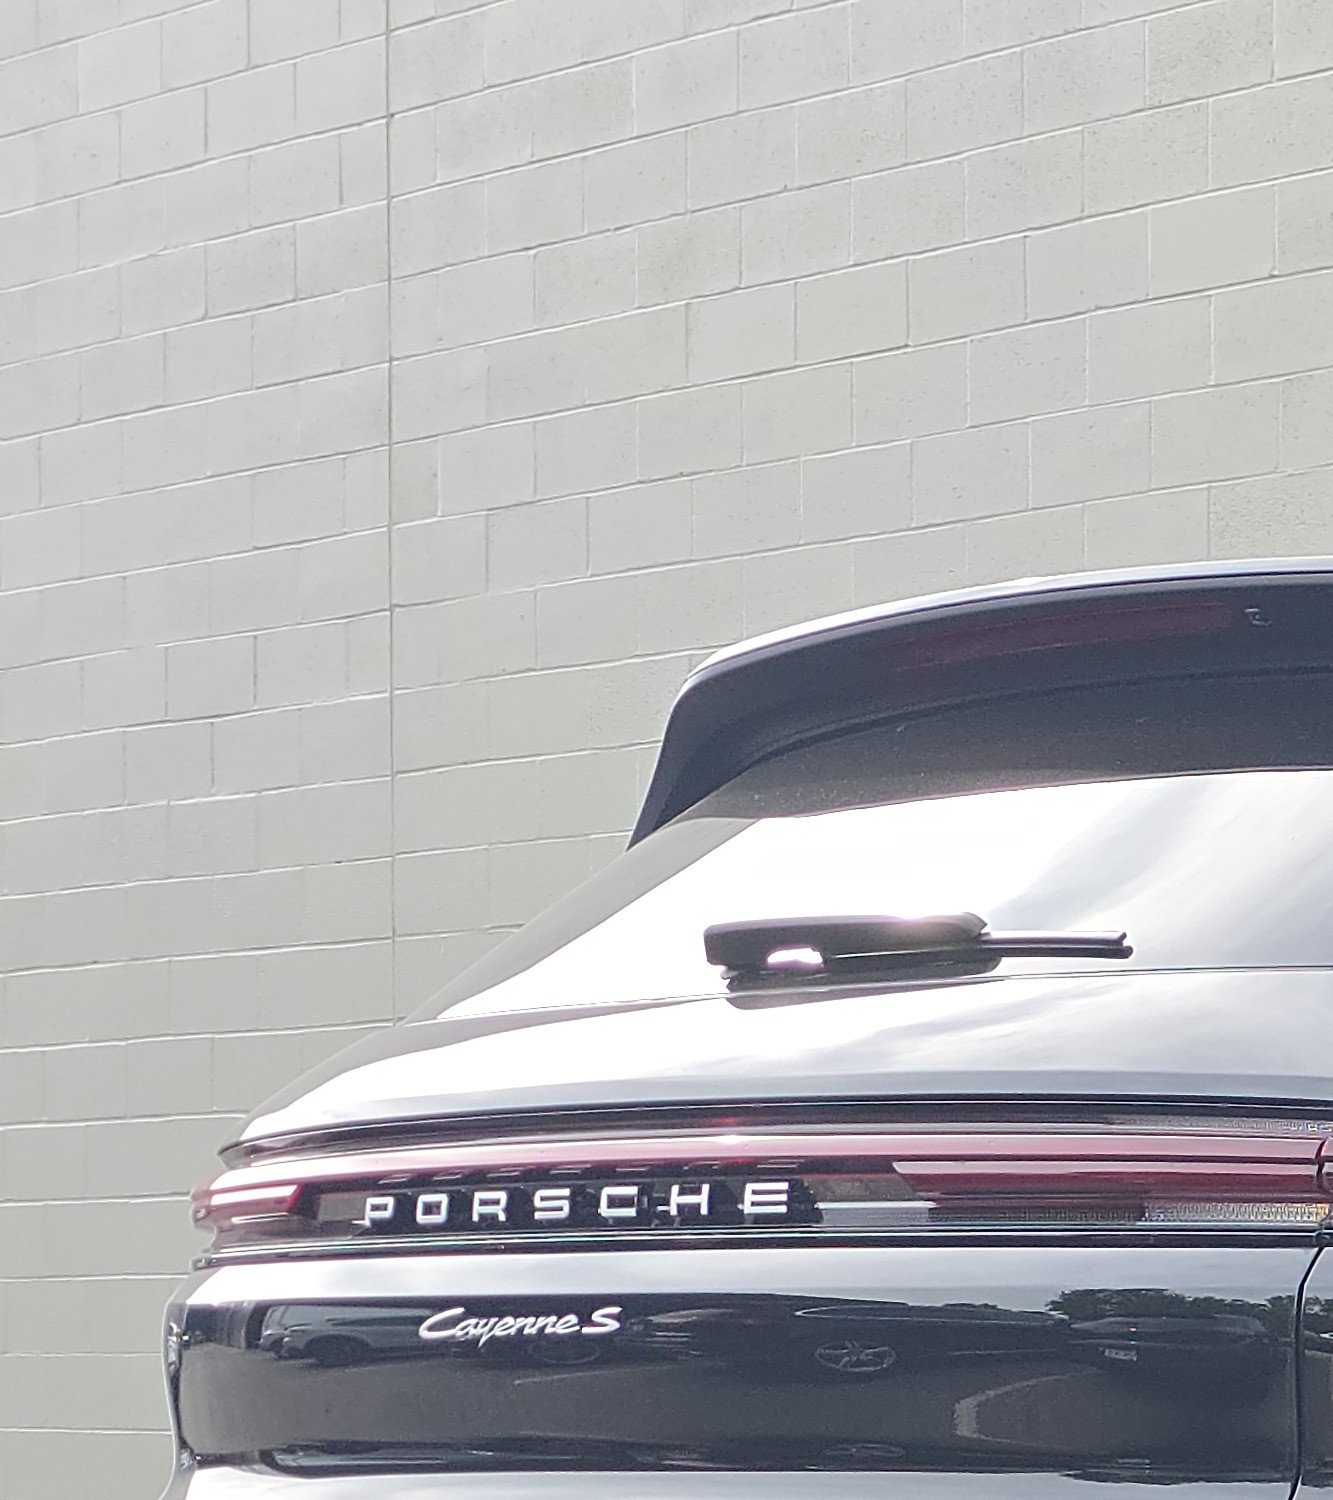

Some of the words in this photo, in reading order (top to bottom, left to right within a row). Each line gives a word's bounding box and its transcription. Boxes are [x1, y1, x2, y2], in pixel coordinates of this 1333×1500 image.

[365, 1182, 789, 1228] PORSCHE
[418, 1306, 580, 1348] Cayenne
[581, 1306, 623, 1334] S
